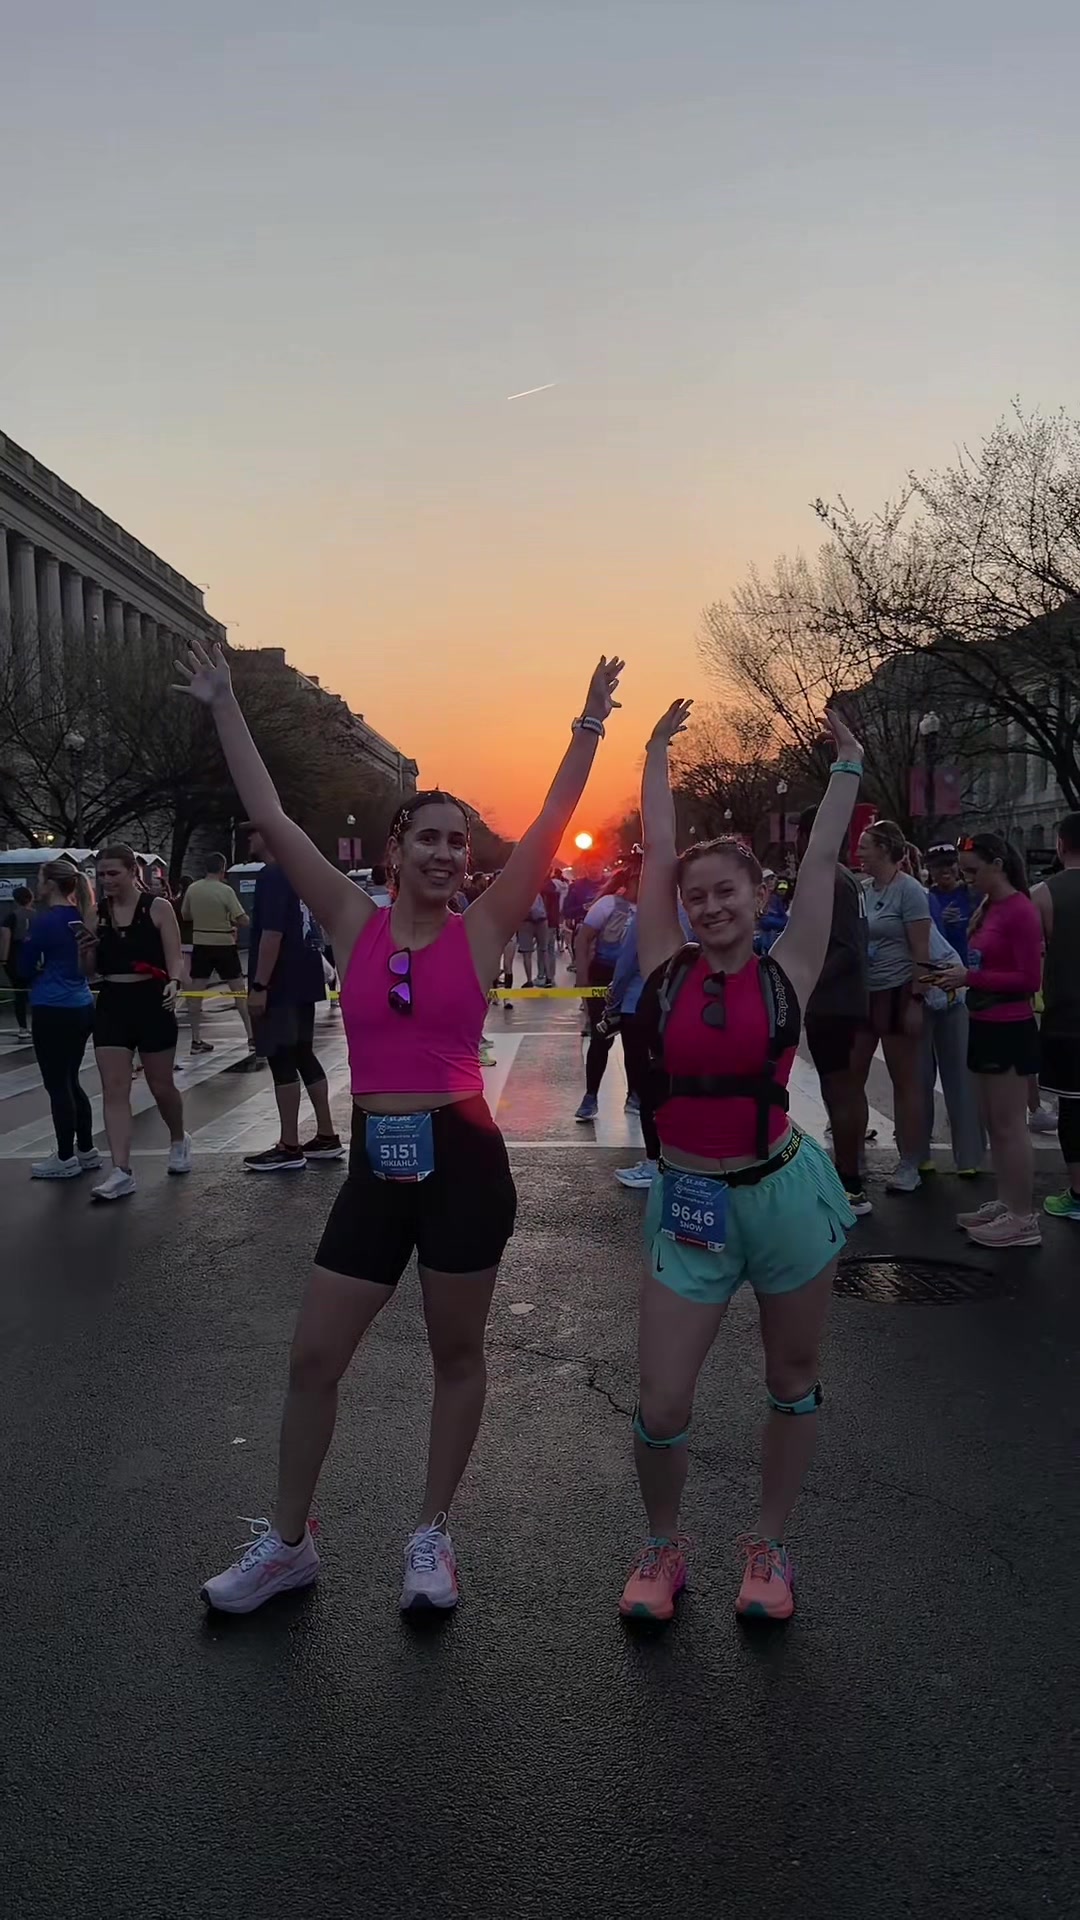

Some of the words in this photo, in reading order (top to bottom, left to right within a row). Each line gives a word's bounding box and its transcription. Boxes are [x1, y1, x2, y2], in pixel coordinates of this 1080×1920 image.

[380, 1143, 417, 1159] 5151
[671, 1202, 715, 1226] 9646
[679, 1220, 703, 1233] SNOW
